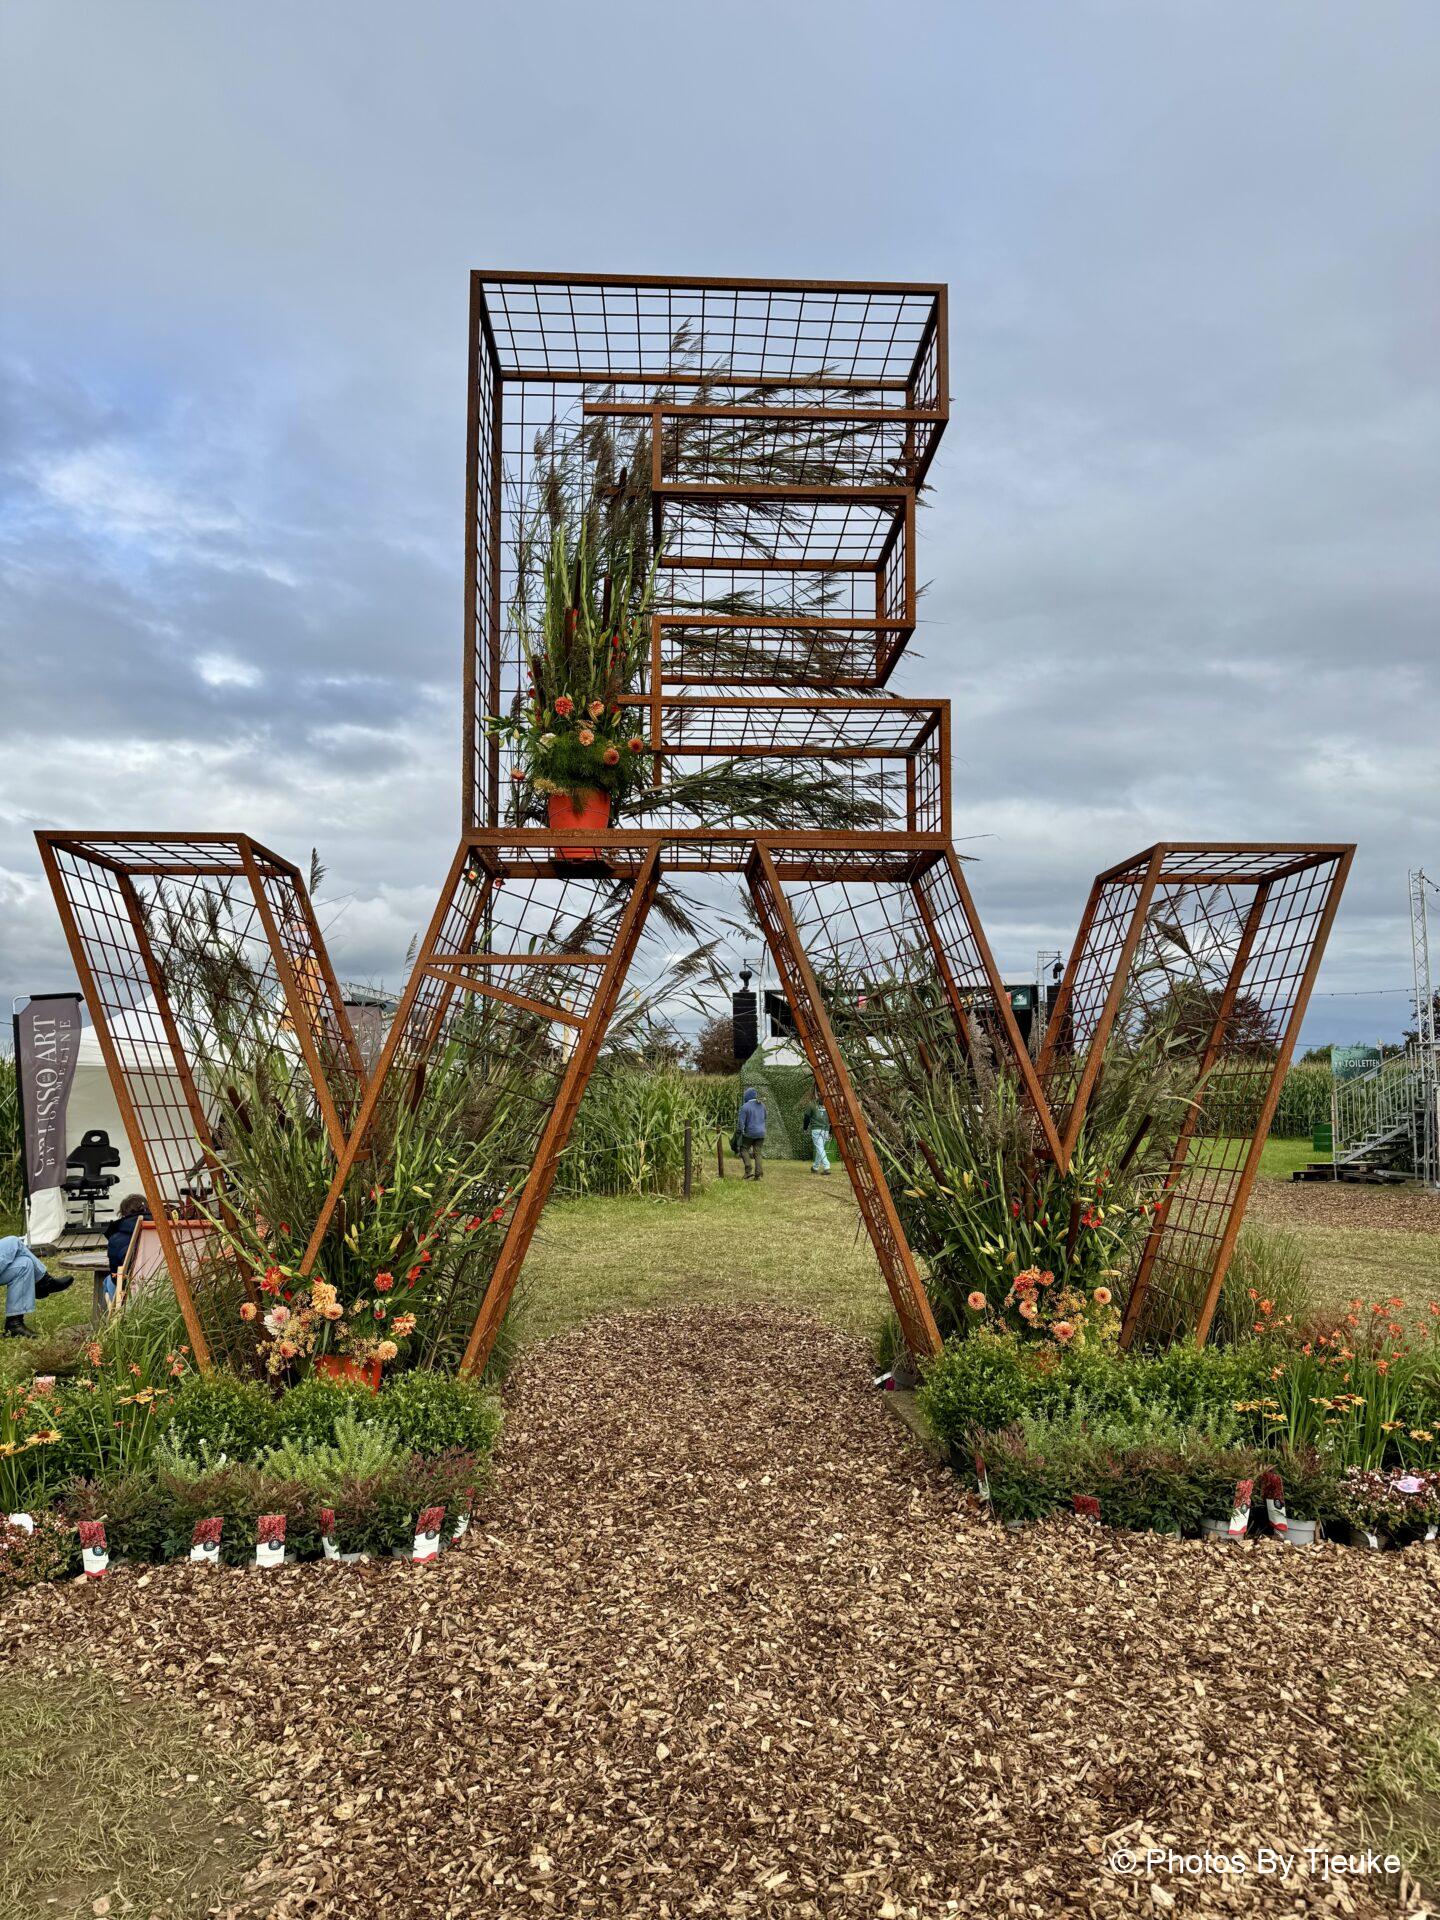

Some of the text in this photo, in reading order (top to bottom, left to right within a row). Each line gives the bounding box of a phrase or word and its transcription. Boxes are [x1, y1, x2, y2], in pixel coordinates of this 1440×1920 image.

[33, 1014, 57, 1062] ART
[1344, 1059, 1380, 1068] TOILETTEN
[46, 1144, 55, 1166] BY
